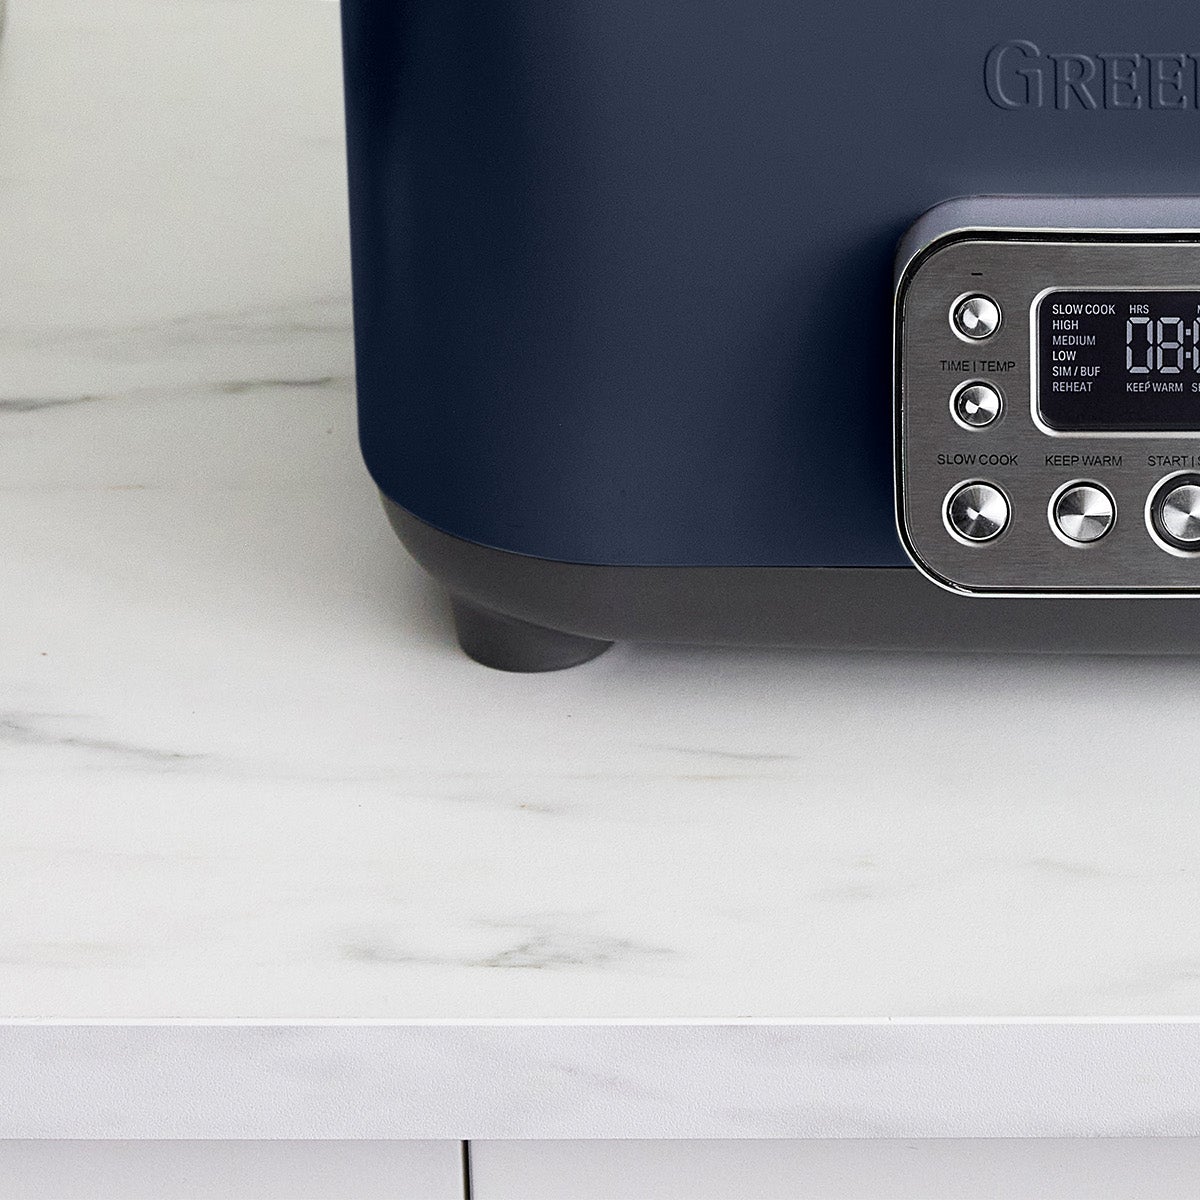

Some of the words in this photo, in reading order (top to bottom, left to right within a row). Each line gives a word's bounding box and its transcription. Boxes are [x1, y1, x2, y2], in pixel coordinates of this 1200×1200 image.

[1052, 305, 1084, 315] SLOW
[1085, 305, 1116, 315] COOK
[1130, 305, 1149, 314] HRS
[1052, 320, 1079, 330] HIGH
[1052, 336, 1096, 346] MEDIUM
[1052, 351, 1076, 361] LOW
[939, 360, 969, 371] TIME
[979, 360, 1016, 371] TEMP
[1052, 366, 1072, 376] SIM
[1081, 366, 1101, 376] BUF
[1052, 382, 1093, 392] REHEAT
[1127, 382, 1150, 392] KEEP
[1152, 382, 1183, 392] WARM
[937, 454, 977, 466] SLOW
[979, 454, 1018, 466] COOK
[1045, 454, 1081, 466] KEEP
[1082, 454, 1123, 466] WARM
[1148, 454, 1189, 466] START
